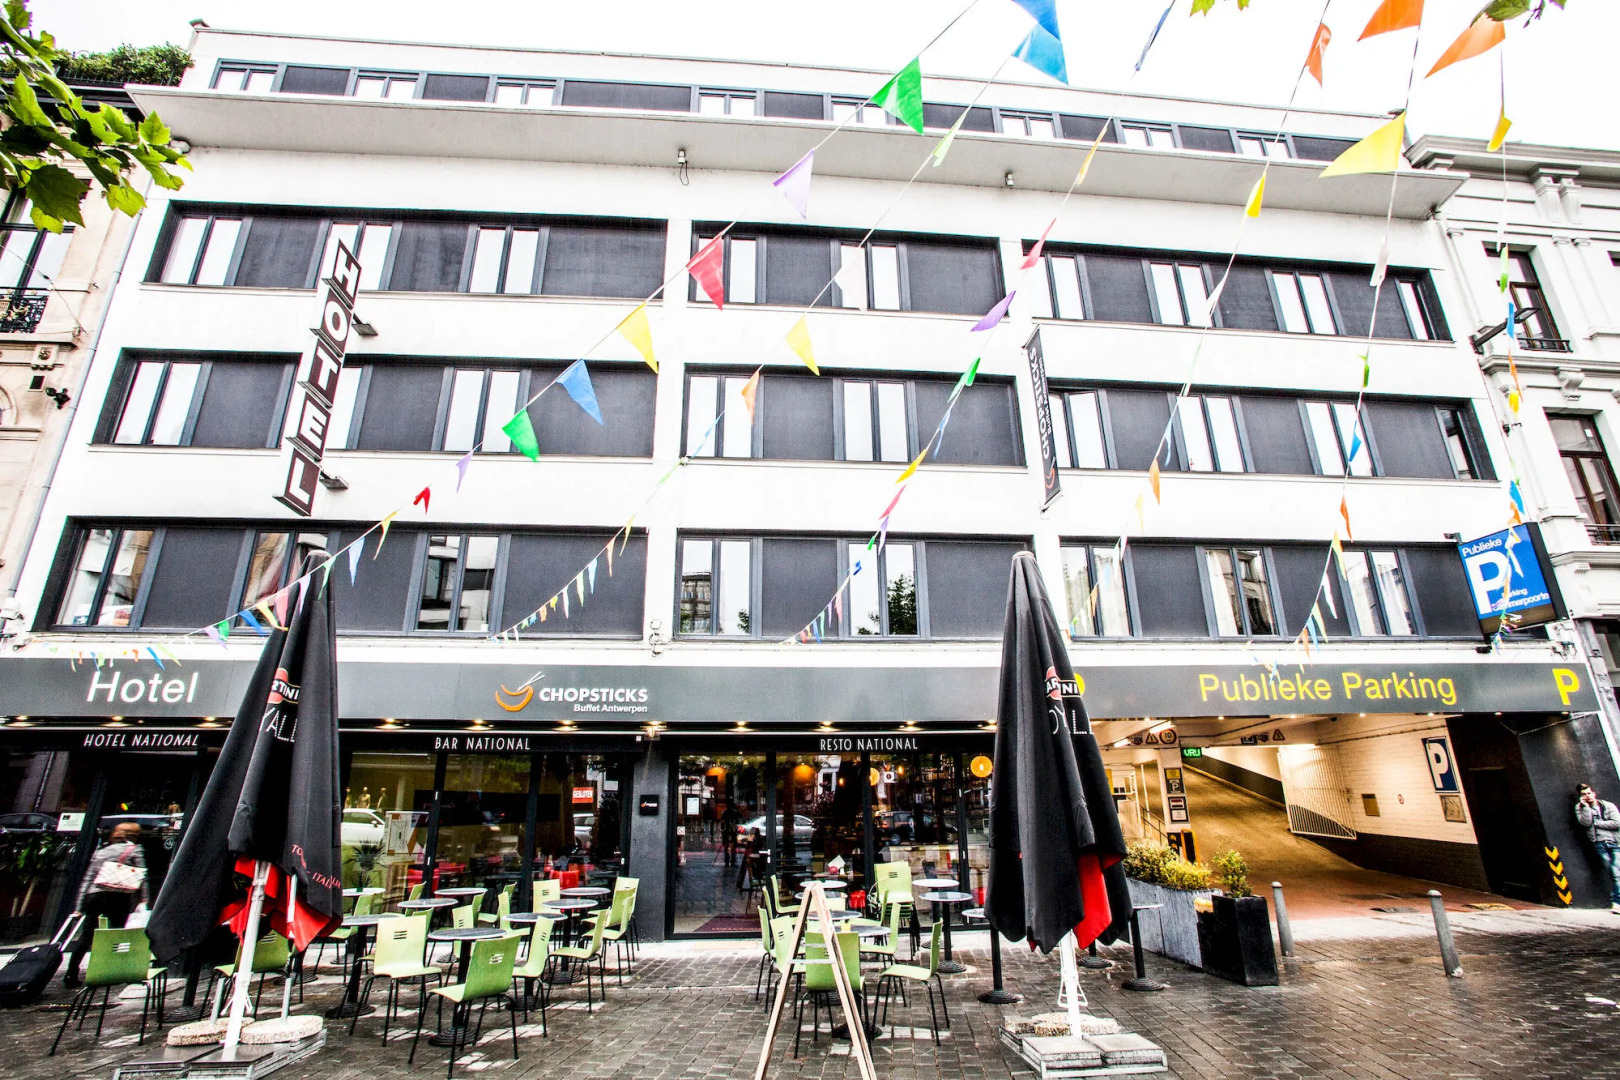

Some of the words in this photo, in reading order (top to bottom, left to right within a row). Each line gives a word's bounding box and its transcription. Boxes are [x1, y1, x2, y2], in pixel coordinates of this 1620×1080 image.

[288, 246, 360, 506] HOTEL
[1029, 346, 1050, 460] CHOPSTICKS
[1462, 538, 1502, 557] Publieke
[1465, 550, 1512, 615] P
[86, 671, 199, 703] Hotel
[539, 687, 649, 703] CHOPSTICKS
[1198, 673, 1331, 702] Publieke
[1341, 672, 1458, 706] Parking
[1551, 668, 1581, 706] P
[573, 704, 601, 713] Buffet
[601, 704, 648, 714] Antwerpen
[83, 733, 126, 747] HOTEL
[131, 733, 199, 747] NATIONAL
[434, 737, 458, 750] BAR
[465, 737, 531, 750] NATIONAL
[820, 738, 852, 751] RESTO
[857, 737, 919, 751] NATIONAL
[1428, 742, 1449, 789] P
